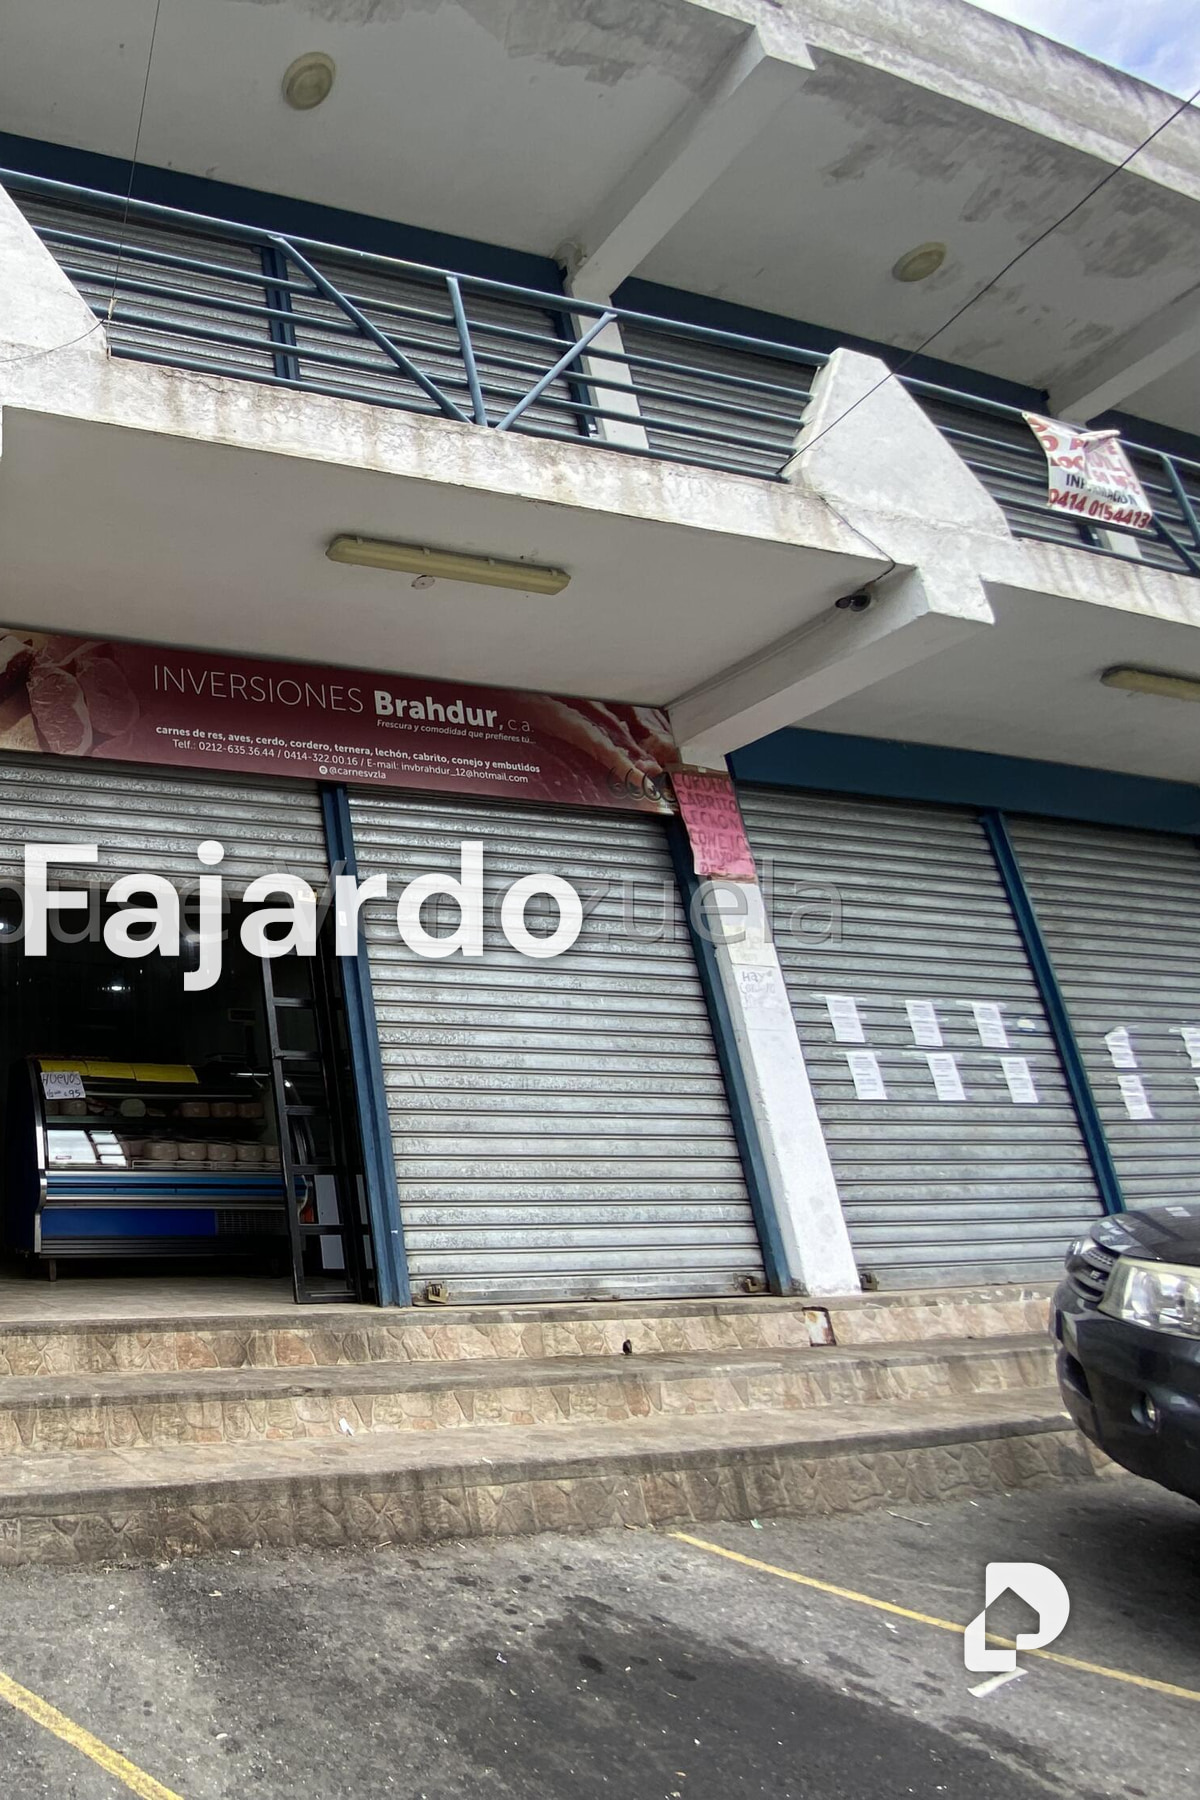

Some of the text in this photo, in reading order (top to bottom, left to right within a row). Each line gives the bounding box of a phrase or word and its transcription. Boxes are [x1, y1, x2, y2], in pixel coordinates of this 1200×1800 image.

[153, 664, 364, 714] INVERSIONES
[376, 718, 413, 733] Frescura
[420, 723, 467, 738] comodidad
[468, 729, 485, 741] que
[485, 730, 520, 744] prefieres
[155, 725, 191, 738] carnes
[192, 727, 206, 739] de
[207, 730, 226, 743] res,
[227, 733, 254, 745] aves,
[255, 733, 288, 749] cerdo,
[289, 737, 333, 753] cordero,
[334, 742, 374, 757] ternera,
[375, 745, 411, 761] lechón,
[412, 751, 450, 766] cabrito,
[451, 756, 484, 770] conejo
[492, 758, 540, 774] embutidos
[198, 740, 275, 759] 0212-635.36.44
[283, 749, 358, 768] 0414-322.00.16
[367, 758, 400, 770] E-mail:
[328, 765, 387, 779] @carnesvzla
